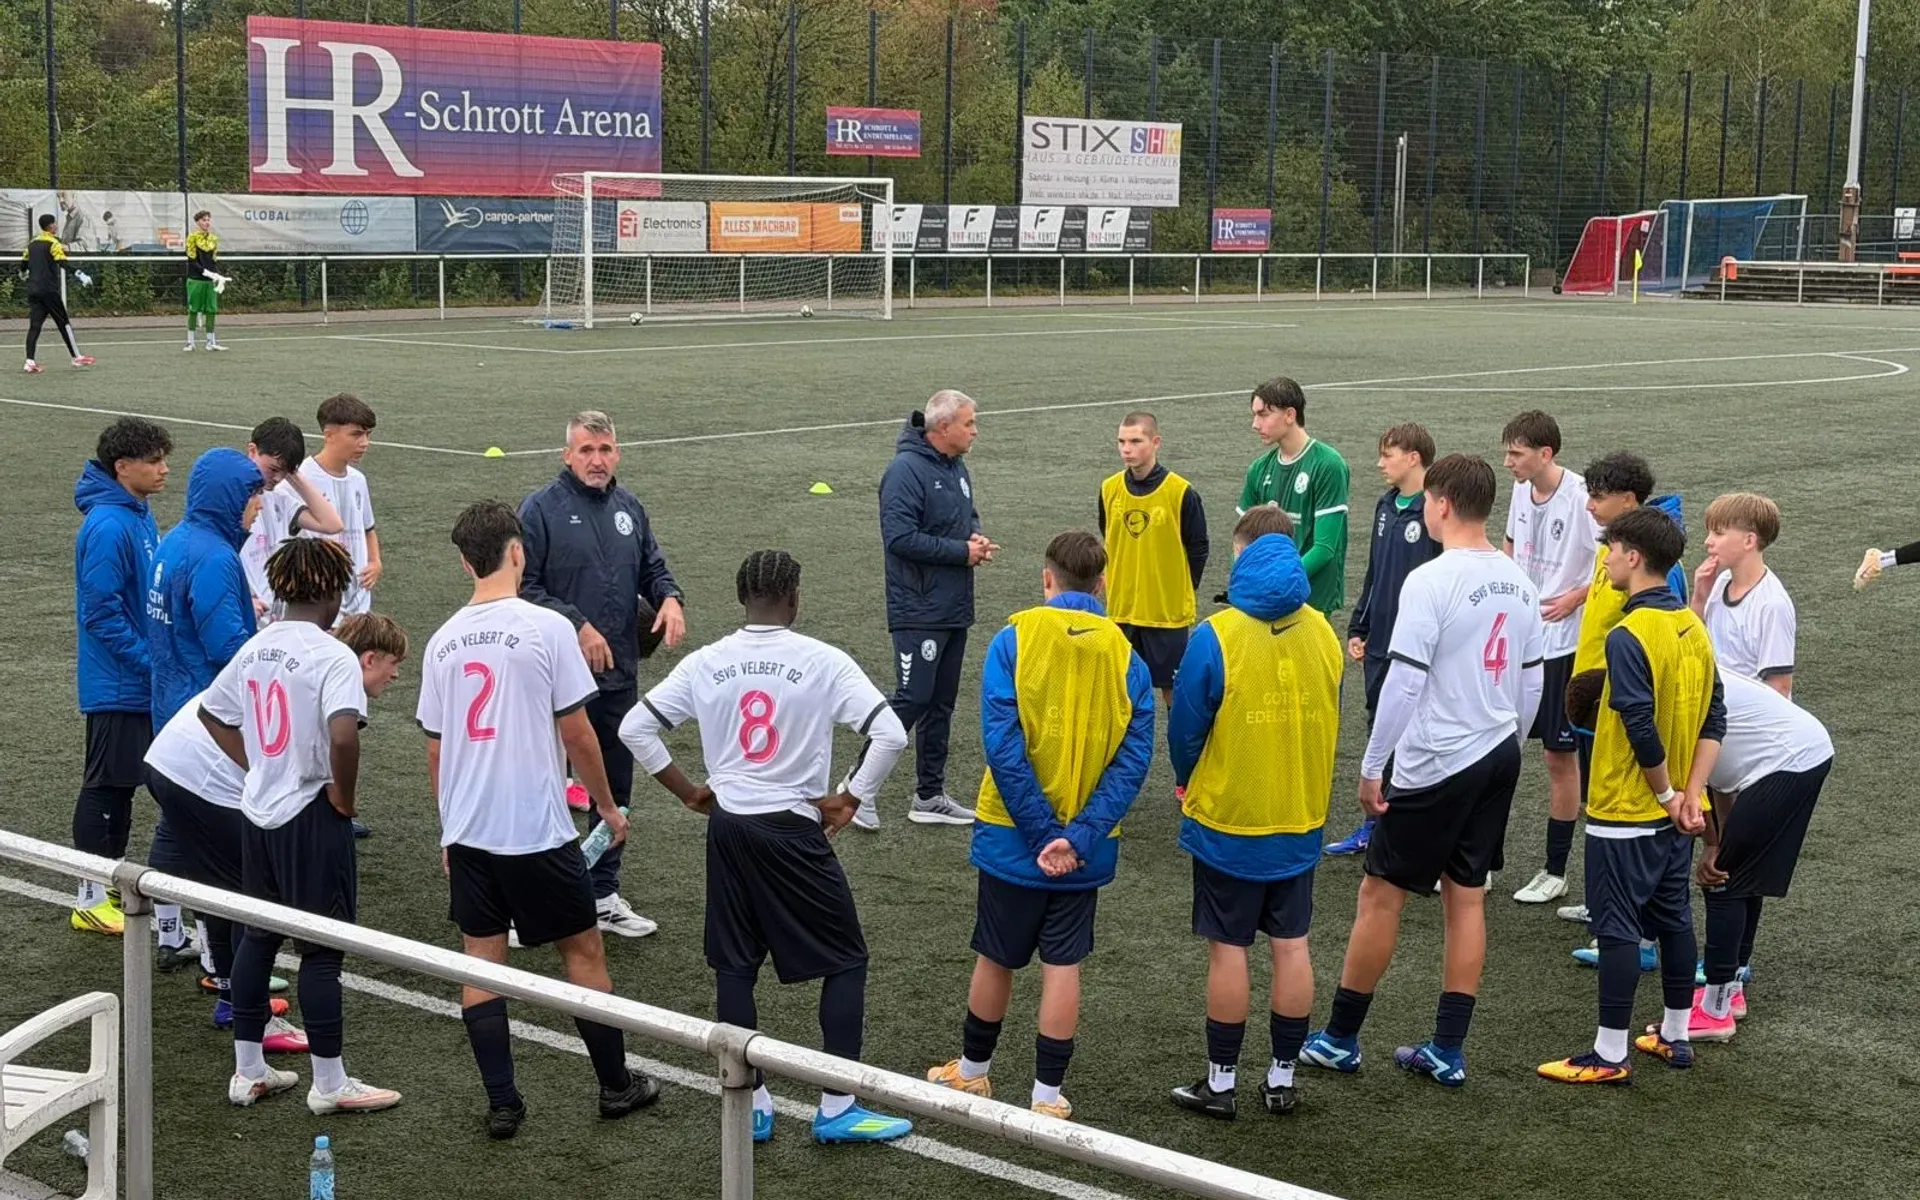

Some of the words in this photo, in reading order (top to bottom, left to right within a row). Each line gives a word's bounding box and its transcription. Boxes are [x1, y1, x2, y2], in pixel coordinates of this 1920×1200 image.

[553, 98, 653, 139] Arena
[835, 119, 864, 143] HR
[1031, 121, 1121, 153] STIX
[485, 211, 553, 225] cargo-partner
[620, 216, 638, 237] Ei
[643, 216, 702, 230] Electronics
[723, 219, 750, 233] ALLES
[752, 219, 798, 233] MACHBAR
[1218, 218, 1235, 239] HR
[1469, 585, 1488, 607] SSVG
[1488, 581, 1519, 597] VELBERT
[461, 631, 504, 647] VELBERT
[504, 634, 520, 649] 02
[1484, 612, 1508, 687] 4
[285, 658, 300, 673] 02
[713, 664, 737, 685] SSVG
[740, 661, 786, 677] VELBERT
[786, 668, 803, 684] 02
[464, 662, 496, 741] 2
[247, 679, 291, 758] 10
[740, 690, 779, 765] 8
